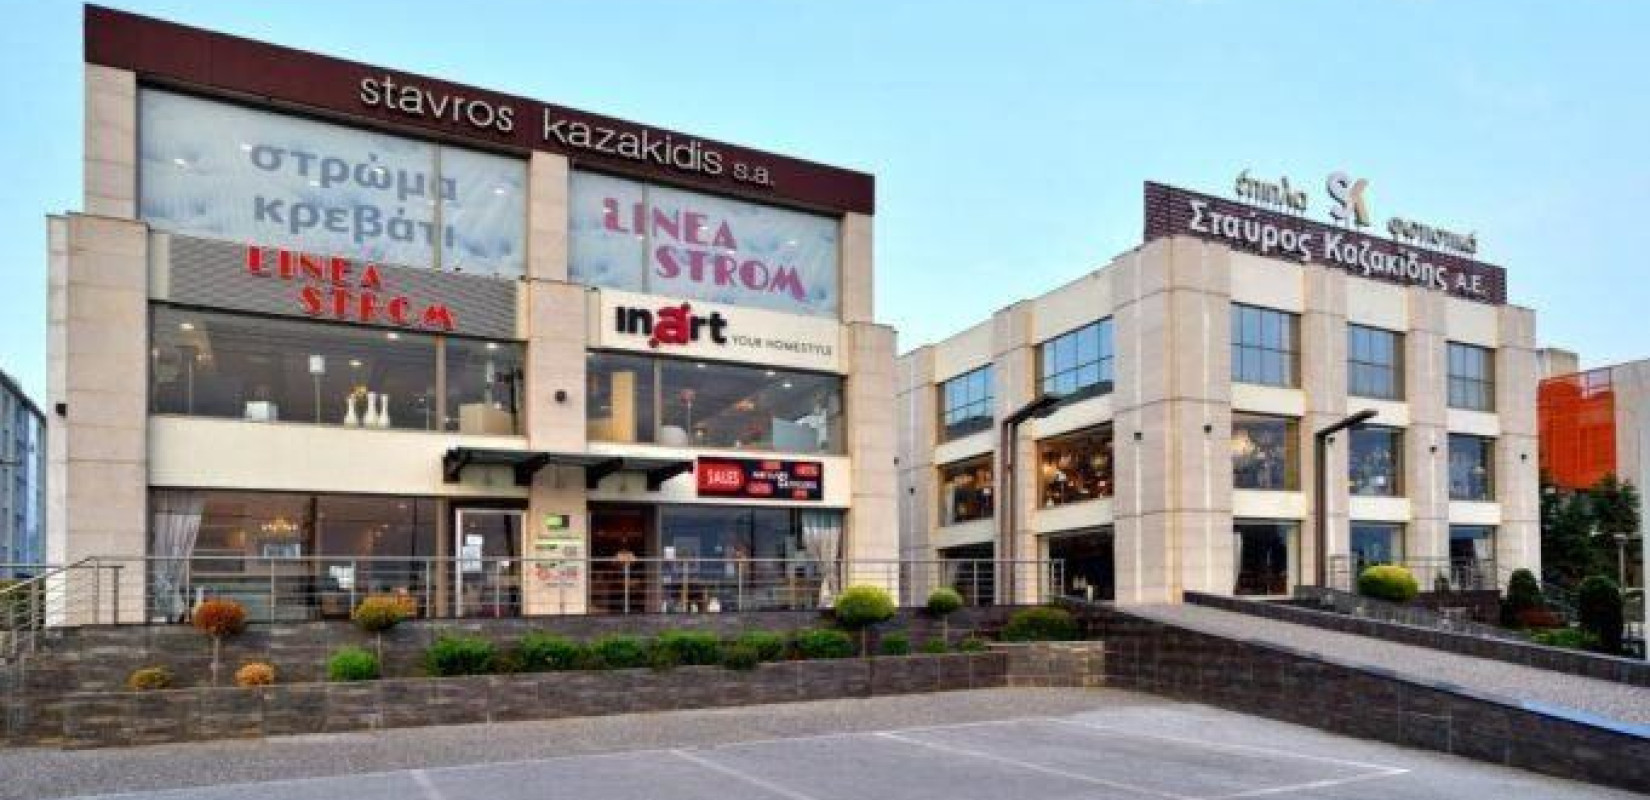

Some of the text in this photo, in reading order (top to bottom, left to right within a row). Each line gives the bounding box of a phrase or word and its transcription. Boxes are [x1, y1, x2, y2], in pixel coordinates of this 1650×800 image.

[360, 73, 776, 186] stavros kazakidis s.a.
[250, 142, 458, 201] στρώμα
[253, 194, 455, 249] κρεβάτι
[602, 197, 737, 250] LINEA
[1190, 200, 1312, 262] Σταύρος
[1323, 231, 1449, 291] Καζακίδης
[246, 244, 381, 289] LINEA
[654, 246, 809, 302] STROM
[302, 285, 457, 331] STROM
[731, 335, 762, 349] YOUR
[765, 340, 832, 356] HOMESTYLE
[706, 468, 740, 487] SALES
